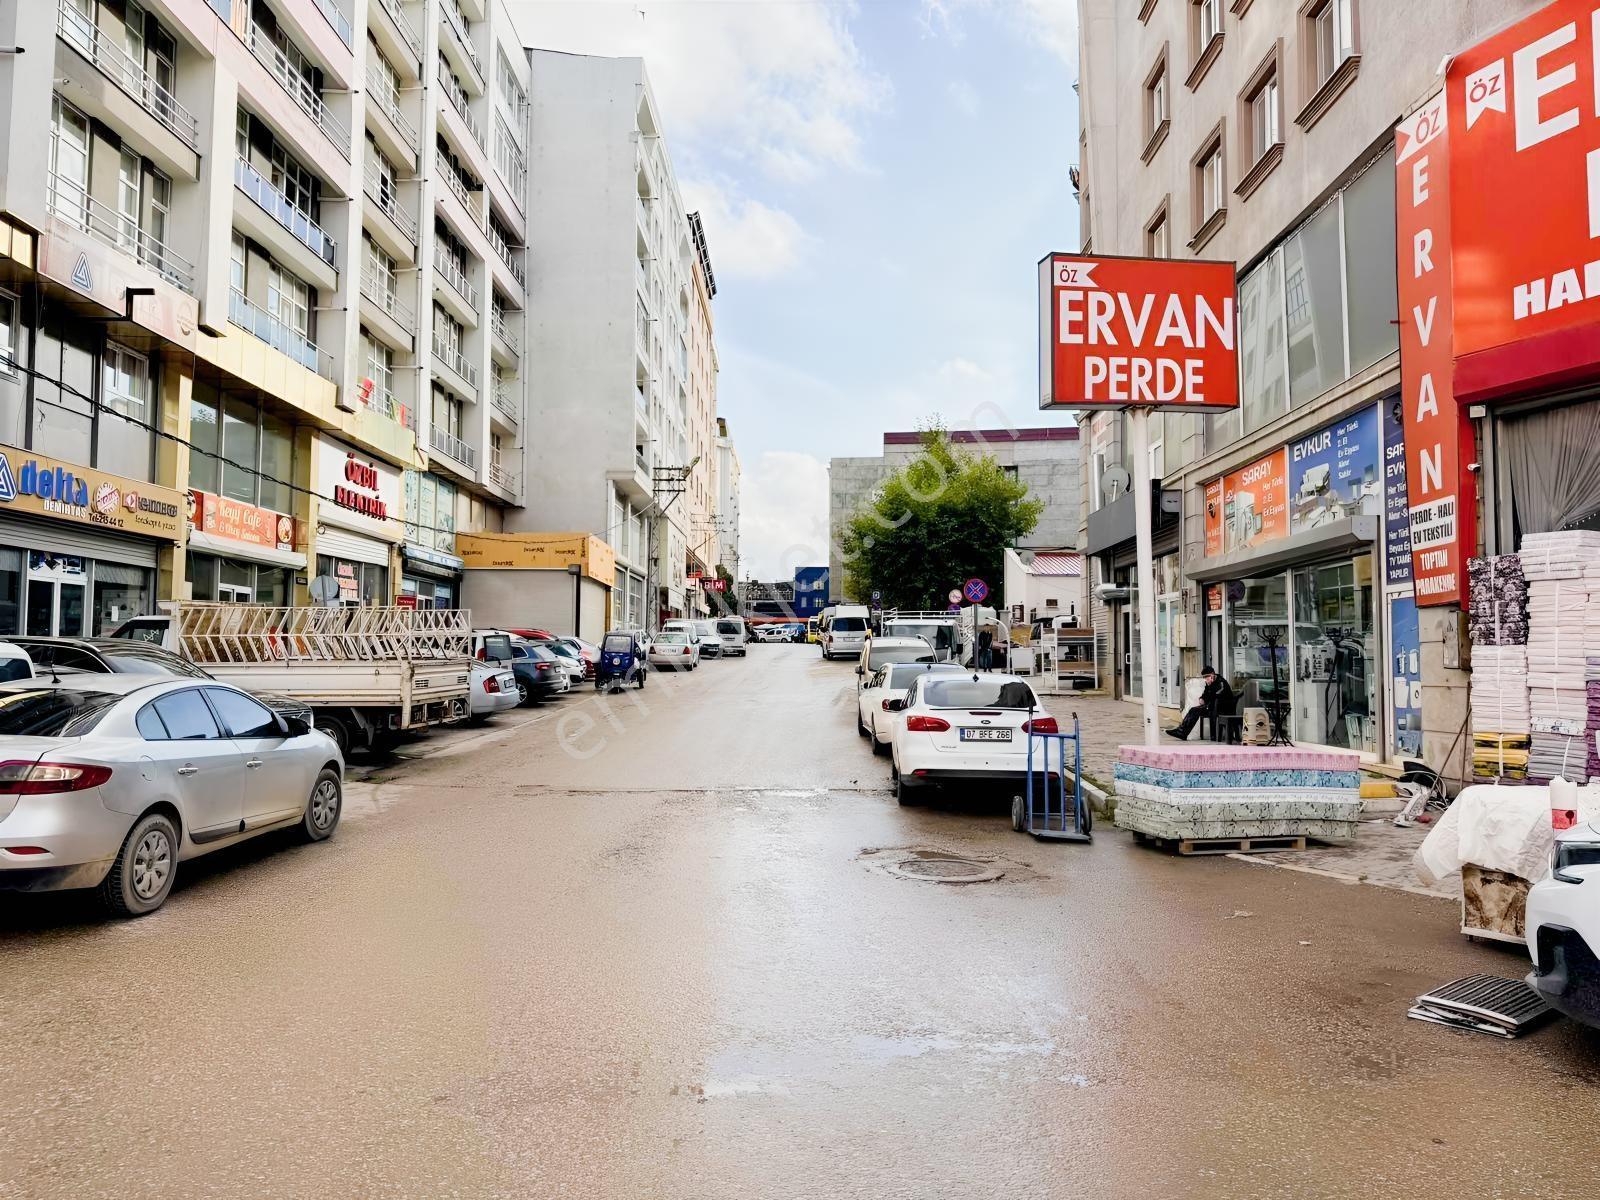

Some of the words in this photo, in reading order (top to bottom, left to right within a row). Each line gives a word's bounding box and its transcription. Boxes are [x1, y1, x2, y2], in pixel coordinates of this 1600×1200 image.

[1469, 74, 1501, 103] ÖZ
[1512, 8, 1600, 152] E
[1415, 110, 1440, 144] ÖZ
[1059, 265, 1078, 283] ÖZ
[1059, 290, 1234, 350] ERVAN
[1413, 155, 1443, 495] ERVAN
[1084, 356, 1205, 402] PERDE
[1294, 431, 1331, 462] EVKUR
[18, 460, 88, 508] delta
[345, 452, 379, 492] ÖZBİL
[1242, 460, 1273, 486] SARAY
[1387, 461, 1406, 477] EVK
[1410, 508, 1433, 526] PERDE
[1413, 530, 1422, 545] EV
[1420, 548, 1448, 571] TOPTAN
